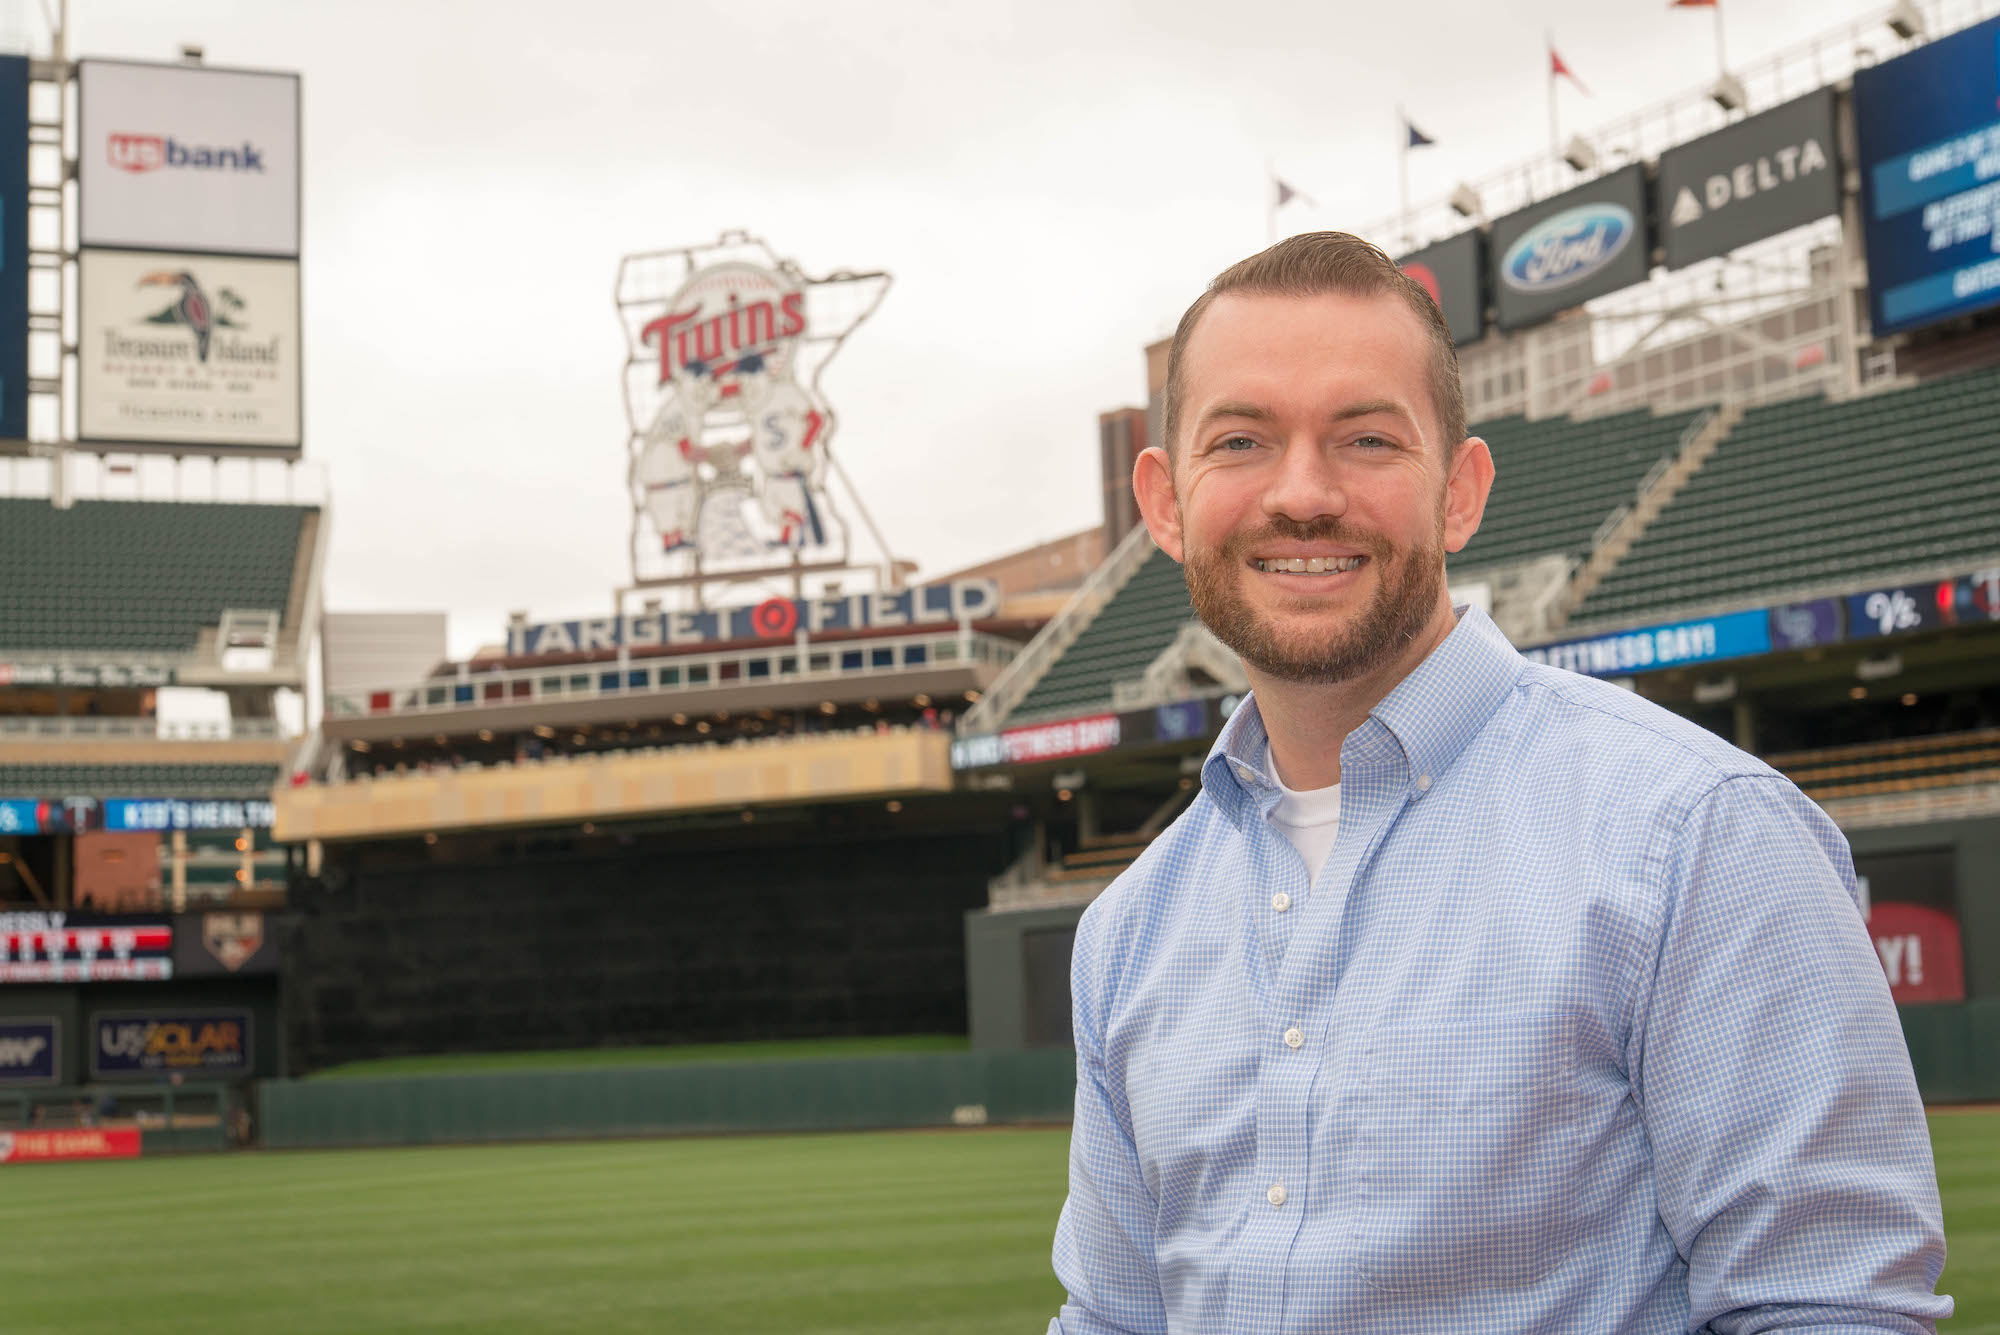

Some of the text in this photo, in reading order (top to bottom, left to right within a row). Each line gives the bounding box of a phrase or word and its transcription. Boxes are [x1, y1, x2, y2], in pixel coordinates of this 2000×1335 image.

[1705, 138, 1827, 211] DELTA
[1526, 222, 1609, 282] Ford
[640, 290, 807, 384] Twins
[508, 580, 1000, 656] TARGET FIELD
[1655, 622, 1717, 663] DAY!
